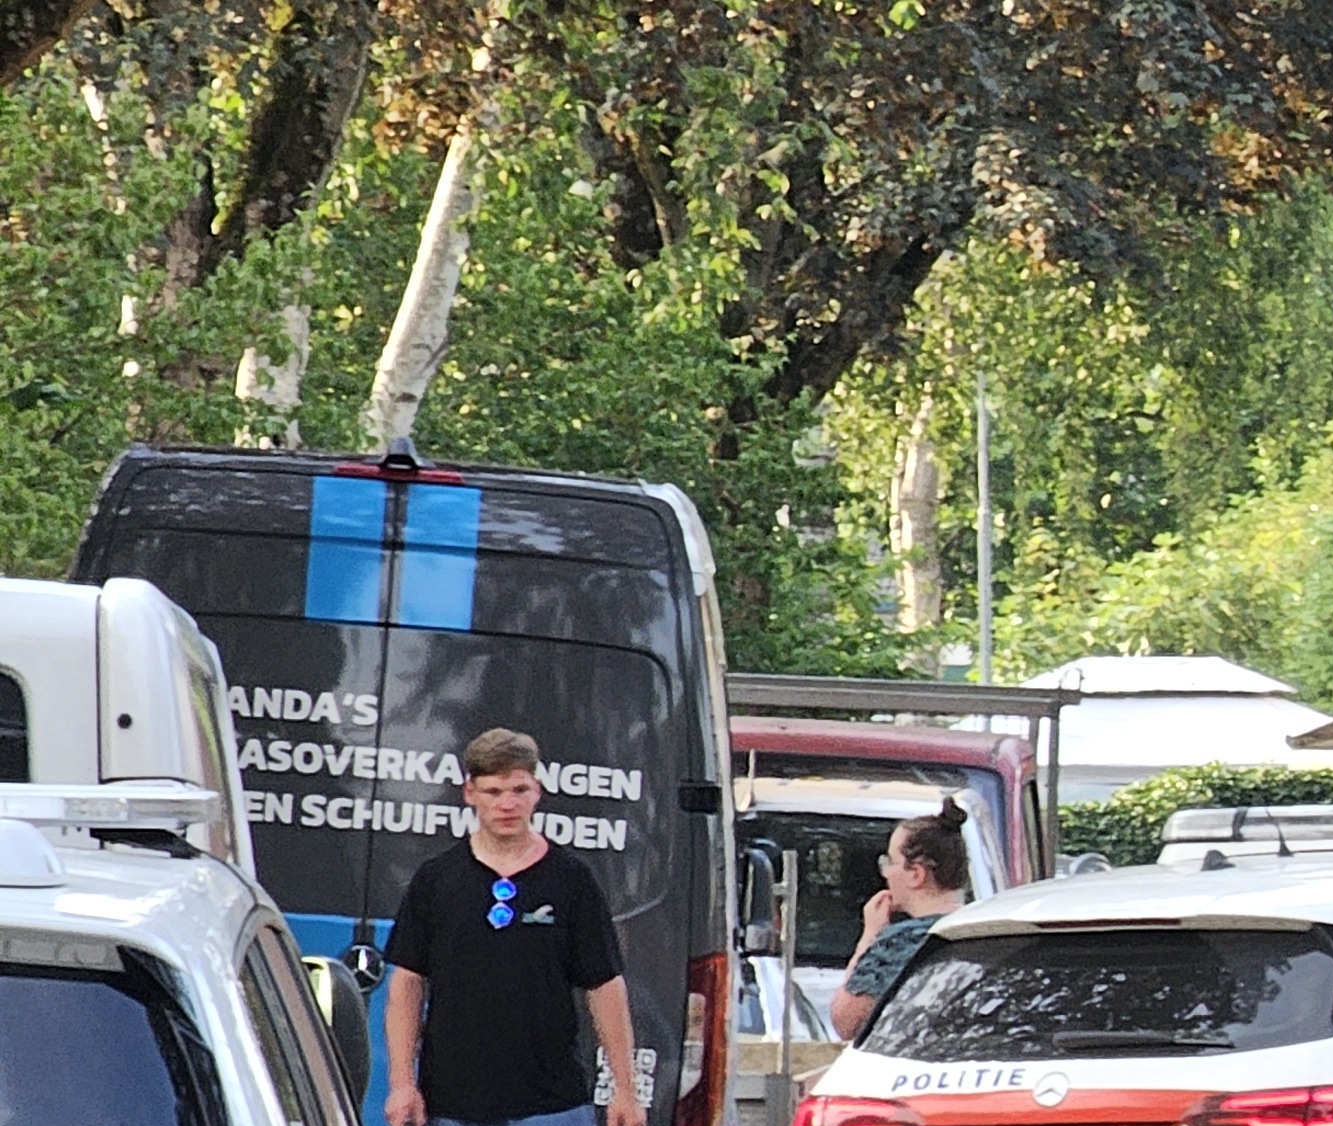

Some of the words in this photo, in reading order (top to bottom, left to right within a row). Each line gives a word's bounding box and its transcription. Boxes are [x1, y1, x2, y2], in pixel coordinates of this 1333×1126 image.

[228, 685, 379, 727] ANDA'S
[237, 738, 643, 801] ASOVERKANGEN
[300, 793, 628, 851] SCHUIFWDEN
[890, 1067, 1027, 1092] POLITIE
